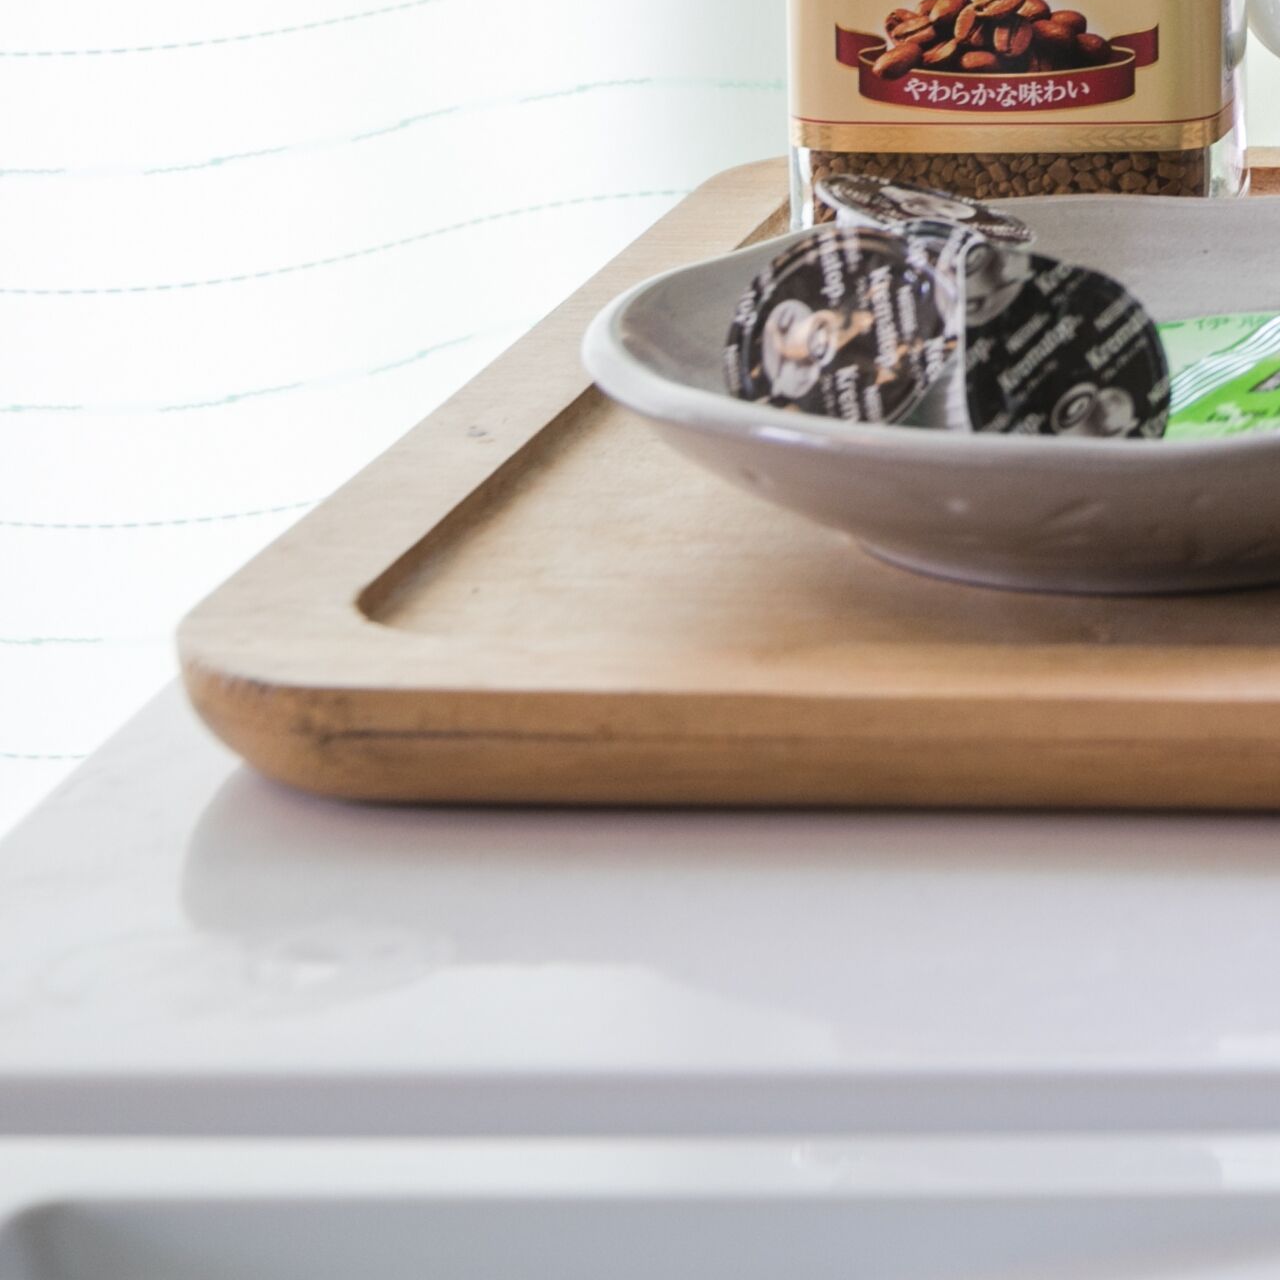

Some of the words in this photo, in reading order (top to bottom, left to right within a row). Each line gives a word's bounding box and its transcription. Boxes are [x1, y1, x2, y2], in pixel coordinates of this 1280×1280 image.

[903, 77, 1091, 108] やわらかな味わい
